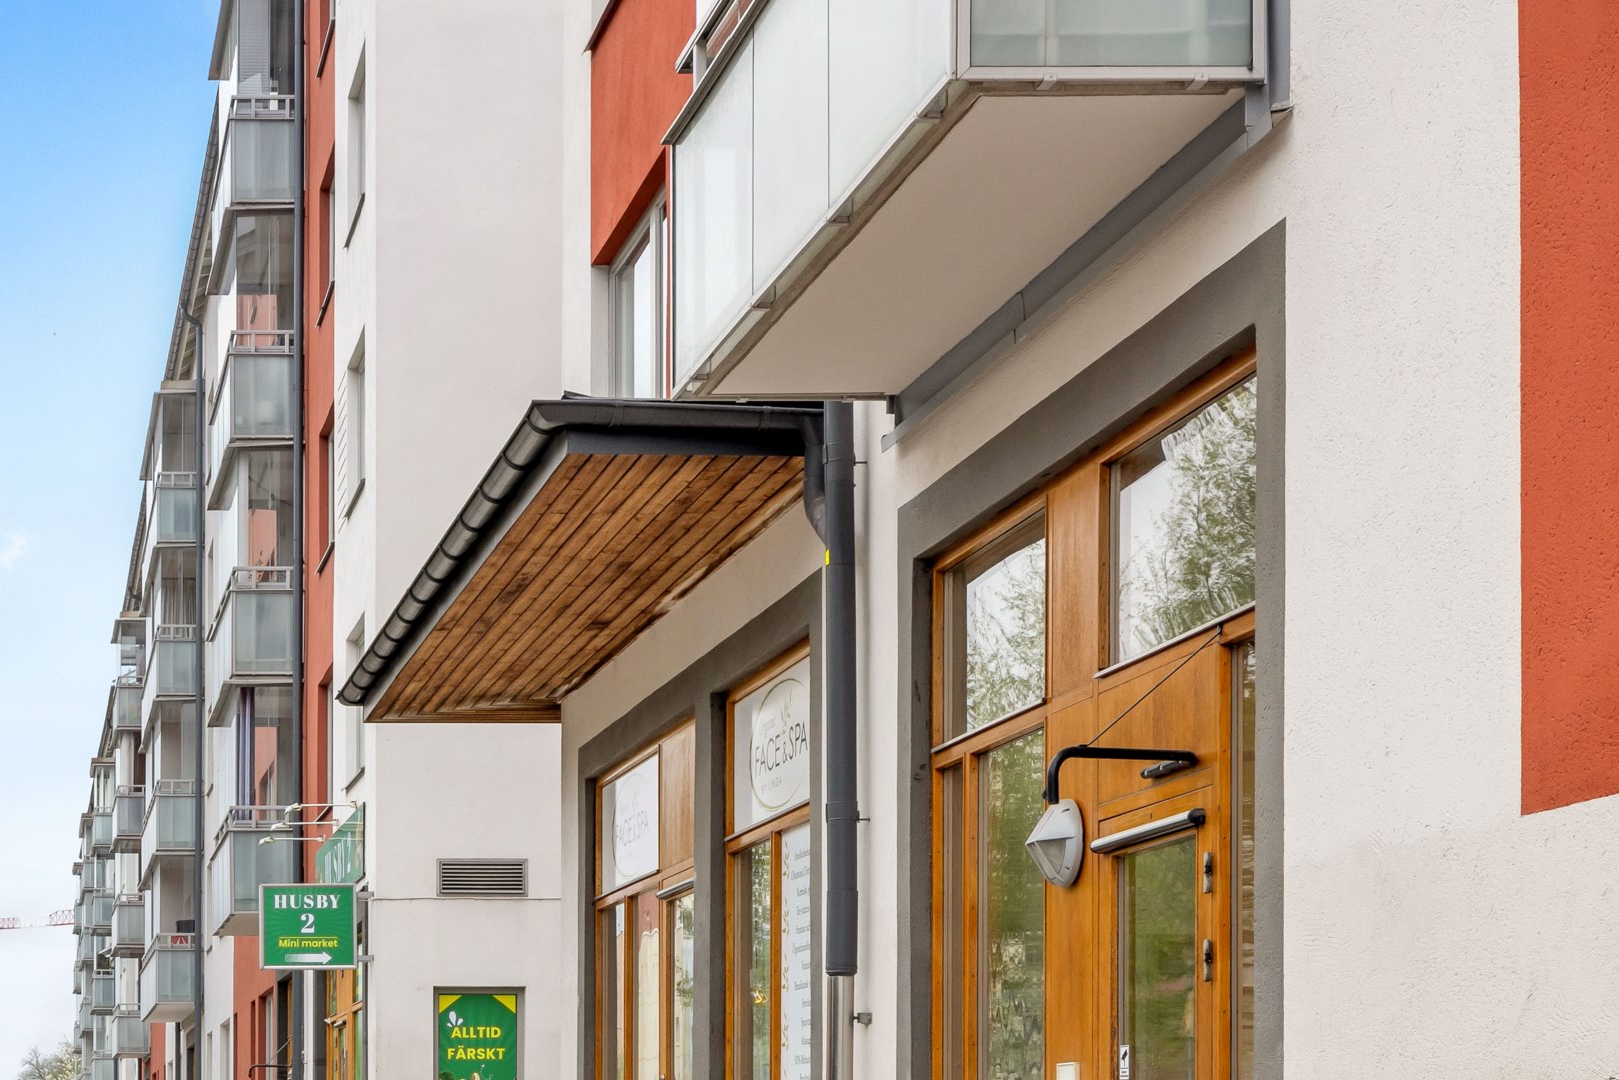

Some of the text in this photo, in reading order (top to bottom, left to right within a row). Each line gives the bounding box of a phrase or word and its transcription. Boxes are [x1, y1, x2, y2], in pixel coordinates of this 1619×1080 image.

[754, 720, 808, 778] FACE & SPA
[637, 808, 649, 839] SPA
[273, 894, 341, 909] HUSBY
[300, 913, 315, 933] 2
[278, 939, 338, 948] Mini market
[451, 1026, 502, 1038] ALLTID
[447, 1045, 506, 1060] FÄRSKT
